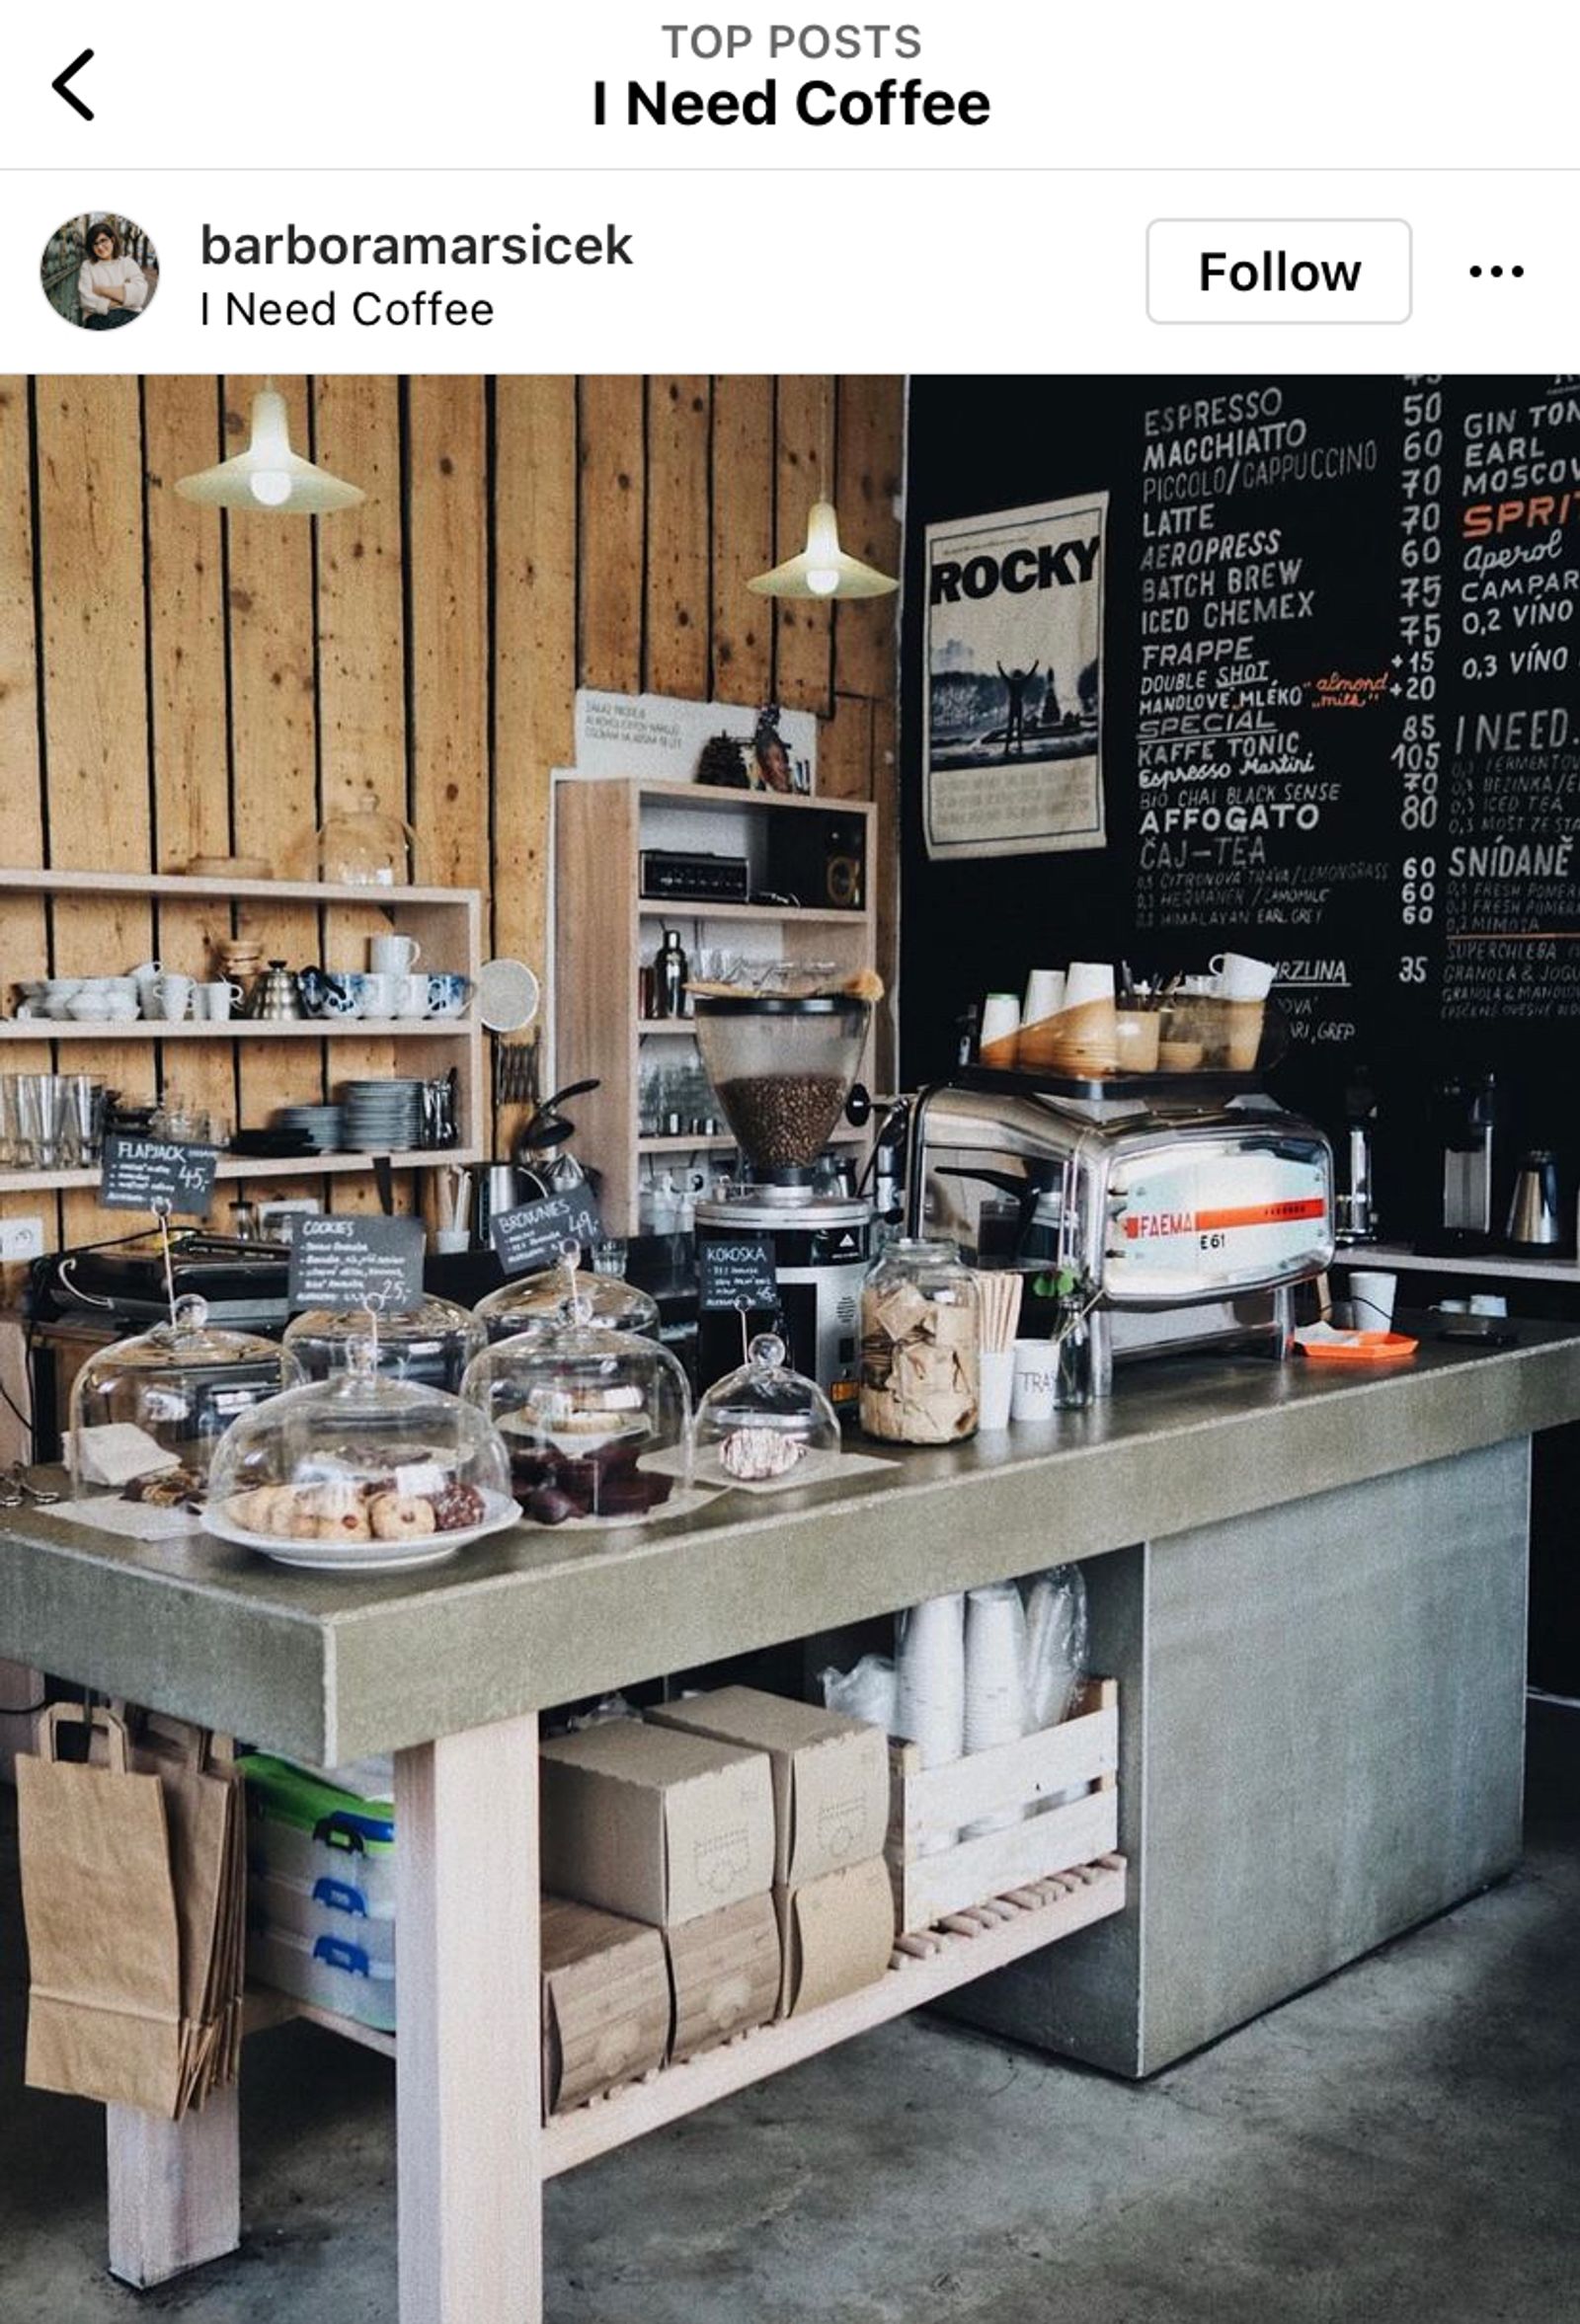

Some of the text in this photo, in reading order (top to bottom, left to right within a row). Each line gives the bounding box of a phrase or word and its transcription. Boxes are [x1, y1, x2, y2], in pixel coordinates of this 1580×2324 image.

[1145, 386, 1282, 436] ESPRESSO
[1403, 392, 1442, 426] 50
[1463, 408, 1517, 440] GIN
[1144, 419, 1306, 472] MACCHIATTO
[1403, 428, 1442, 462] 60
[1464, 436, 1545, 468] EARL
[1401, 464, 1442, 500] 70
[1143, 504, 1215, 538] LATTE
[1400, 503, 1441, 534] 70
[1141, 528, 1282, 571] AEROPRESS
[1401, 536, 1441, 568] 60
[1462, 527, 1563, 580] Aperol
[930, 535, 1100, 606] ROCKY
[1143, 558, 1303, 603] BATCH BREW
[1400, 575, 1441, 608] 75
[1142, 590, 1314, 635] ICED CHEMEX
[1462, 593, 1574, 637] 0,2 VÍNO
[1399, 613, 1441, 648] 75
[1142, 636, 1254, 670] FRAPPE
[1462, 642, 1569, 680] 0,3 VÍNO
[1141, 660, 1270, 695] DOUBLE SHOT
[1316, 670, 1389, 692] almond
[1137, 710, 1276, 739] SPECIAL
[1403, 714, 1436, 741] 85
[1138, 732, 1300, 768] KAFFE TONIC
[1390, 741, 1442, 770] 105
[1139, 751, 1314, 790] Espresso Martini
[1403, 771, 1438, 795] 70
[1226, 785, 1276, 806] BLACK
[1285, 783, 1341, 802] SENSE
[1139, 803, 1320, 834] AFFOGATO
[1401, 794, 1438, 830] 80
[1402, 856, 1436, 880] 60
[1448, 833, 1574, 878] SNÍDANĚ
[1402, 882, 1435, 903] 60
[1402, 905, 1434, 924] 60
[1398, 956, 1428, 982] 35
[118, 1141, 187, 1163] FLAPJACK
[498, 1199, 570, 1234] BROWNIES
[1141, 1212, 1193, 1238] FAEMA
